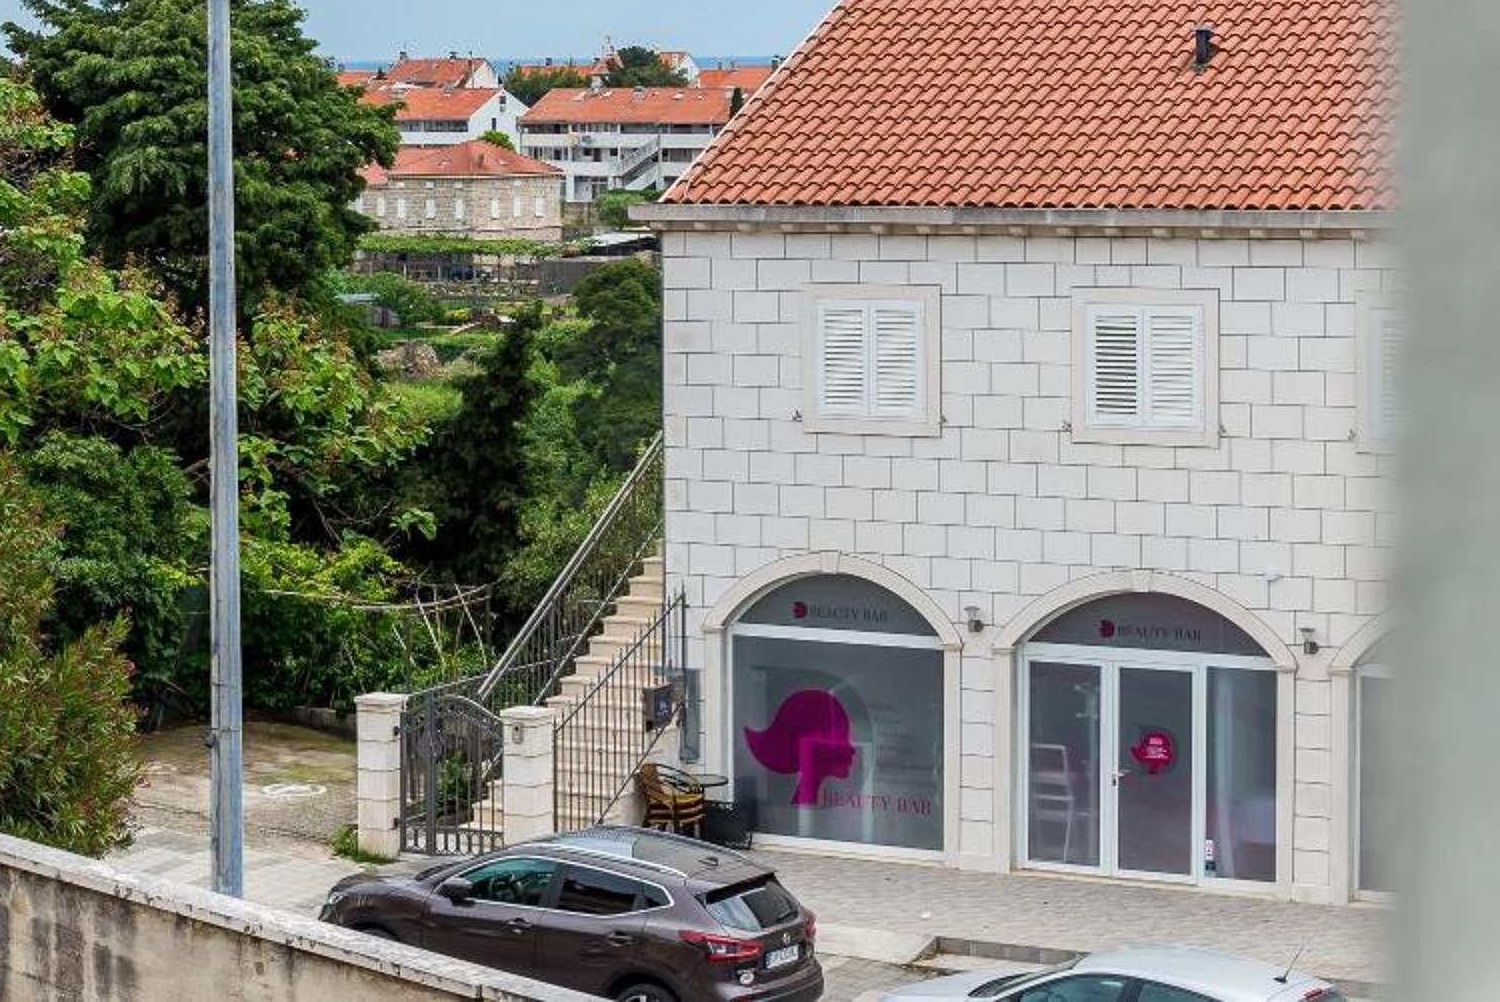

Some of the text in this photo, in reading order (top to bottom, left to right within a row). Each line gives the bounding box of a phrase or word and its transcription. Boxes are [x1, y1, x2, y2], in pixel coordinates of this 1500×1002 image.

[810, 605, 888, 624] BEAUTY BAR
[1117, 624, 1201, 642] BEAUTY BAR
[823, 789, 933, 816] BEAUTY BAR
